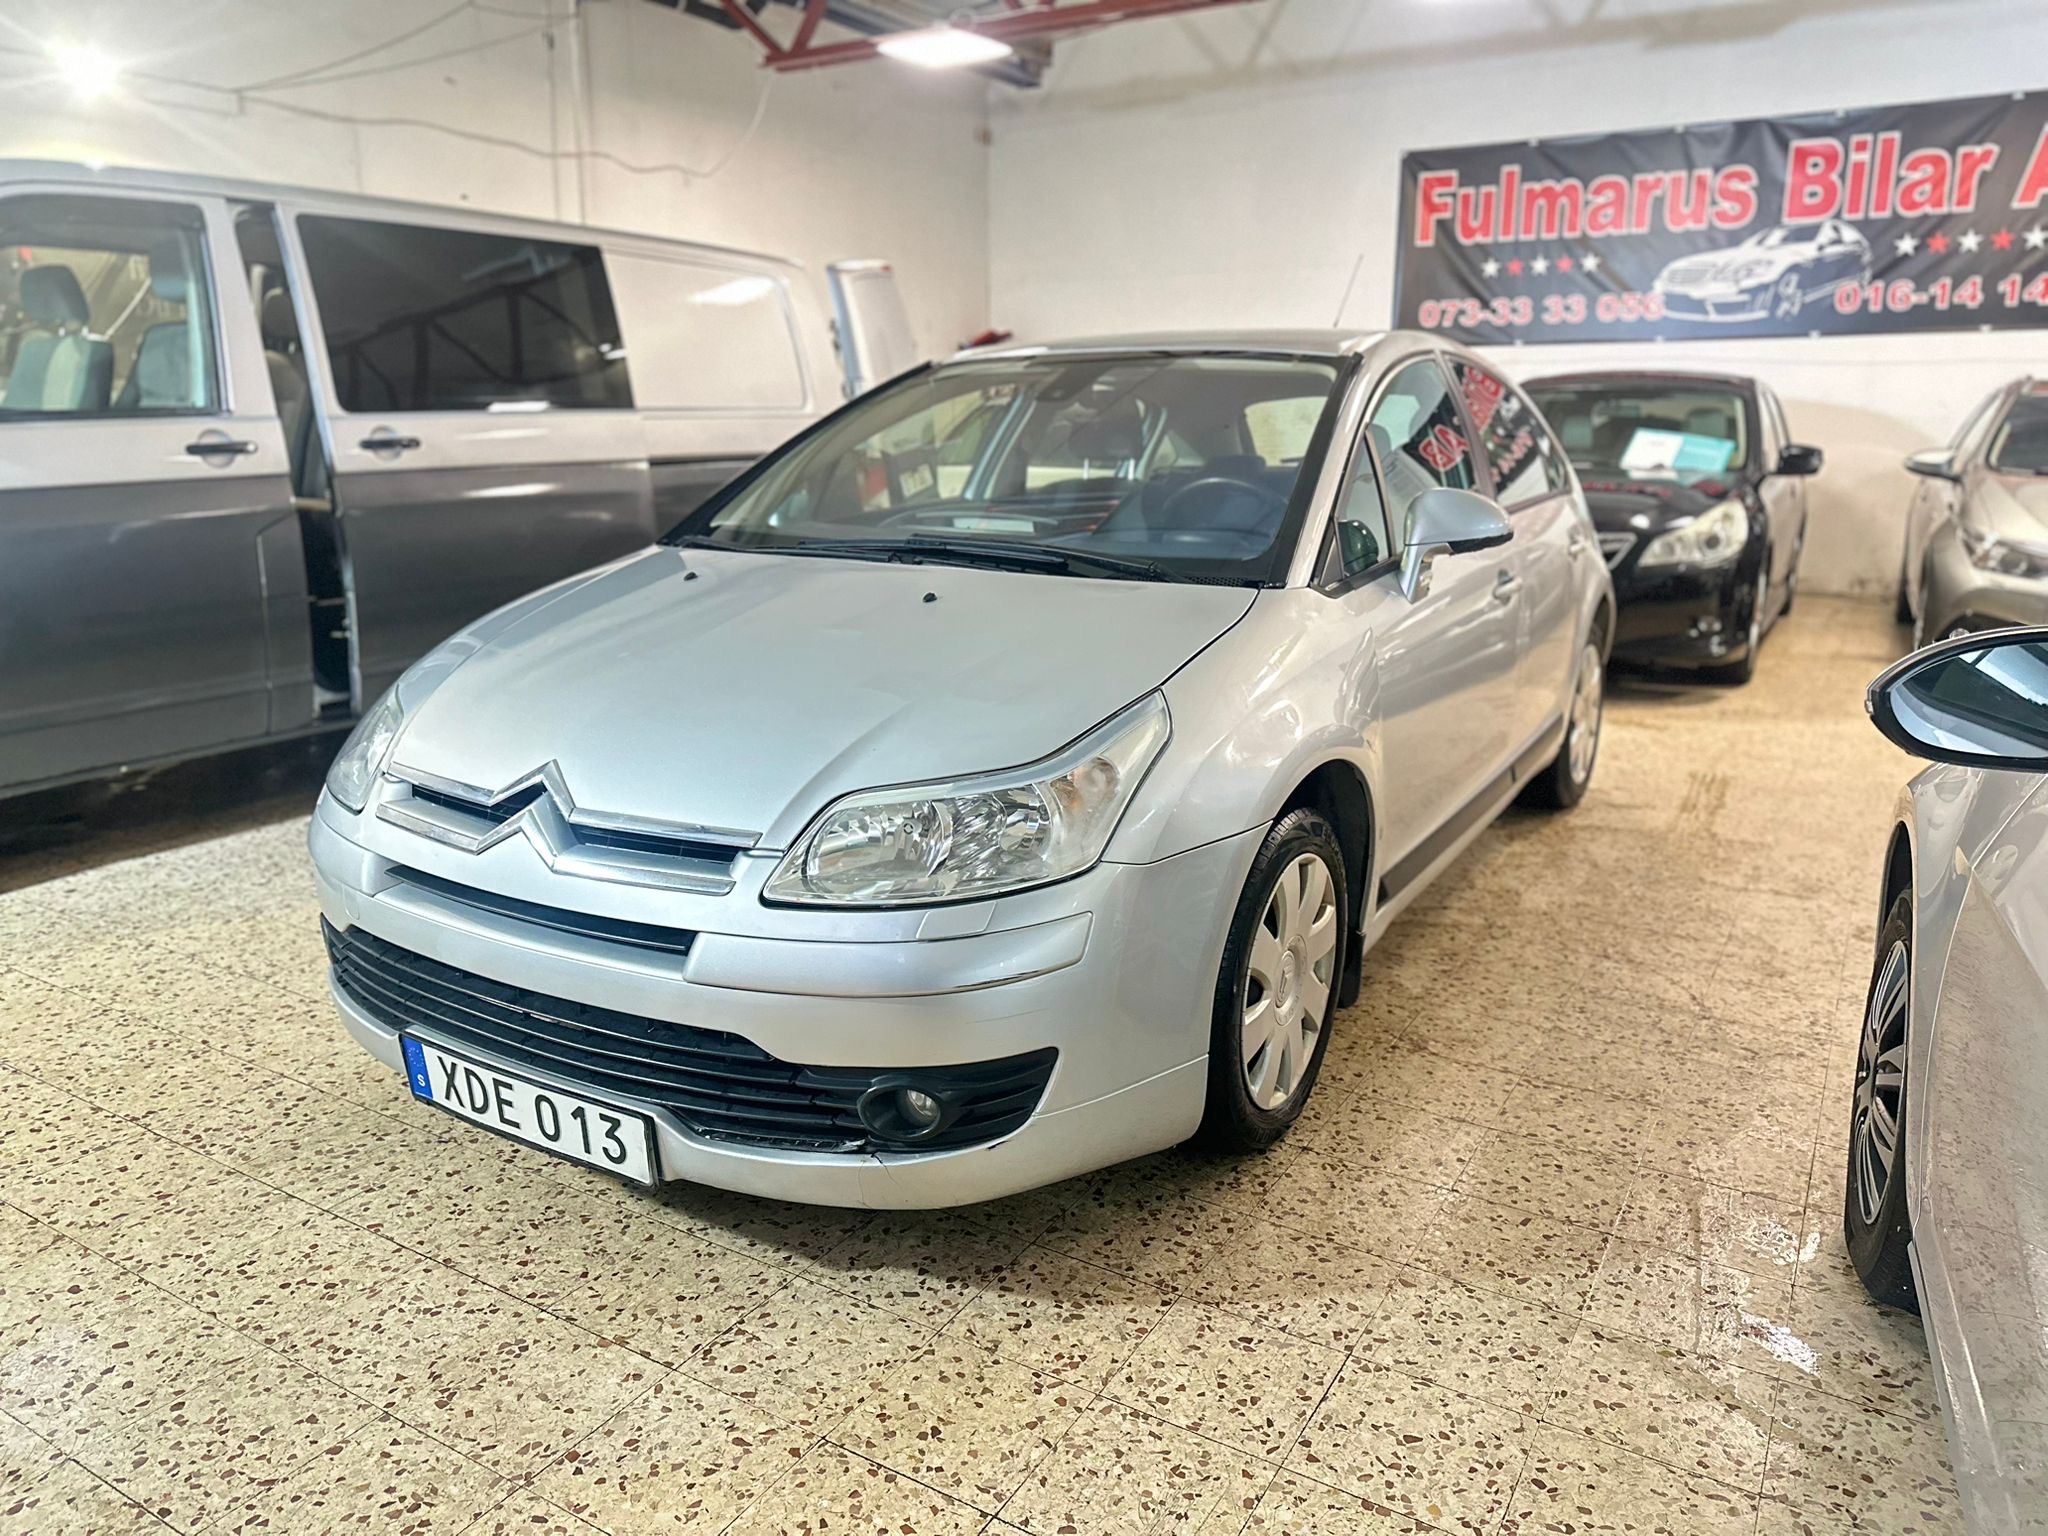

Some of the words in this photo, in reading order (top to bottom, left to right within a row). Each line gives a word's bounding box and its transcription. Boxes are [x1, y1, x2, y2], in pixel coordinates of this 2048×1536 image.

[1414, 163, 1758, 248] Fulmarus
[1782, 131, 2000, 225] Bilar
[1418, 296, 1533, 328] 073-33
[1541, 294, 1588, 325] 33
[1834, 273, 1985, 315] 016-14
[416, 1073, 426, 1087] S
[436, 1055, 521, 1129] XDE
[534, 1093, 627, 1165] 013
